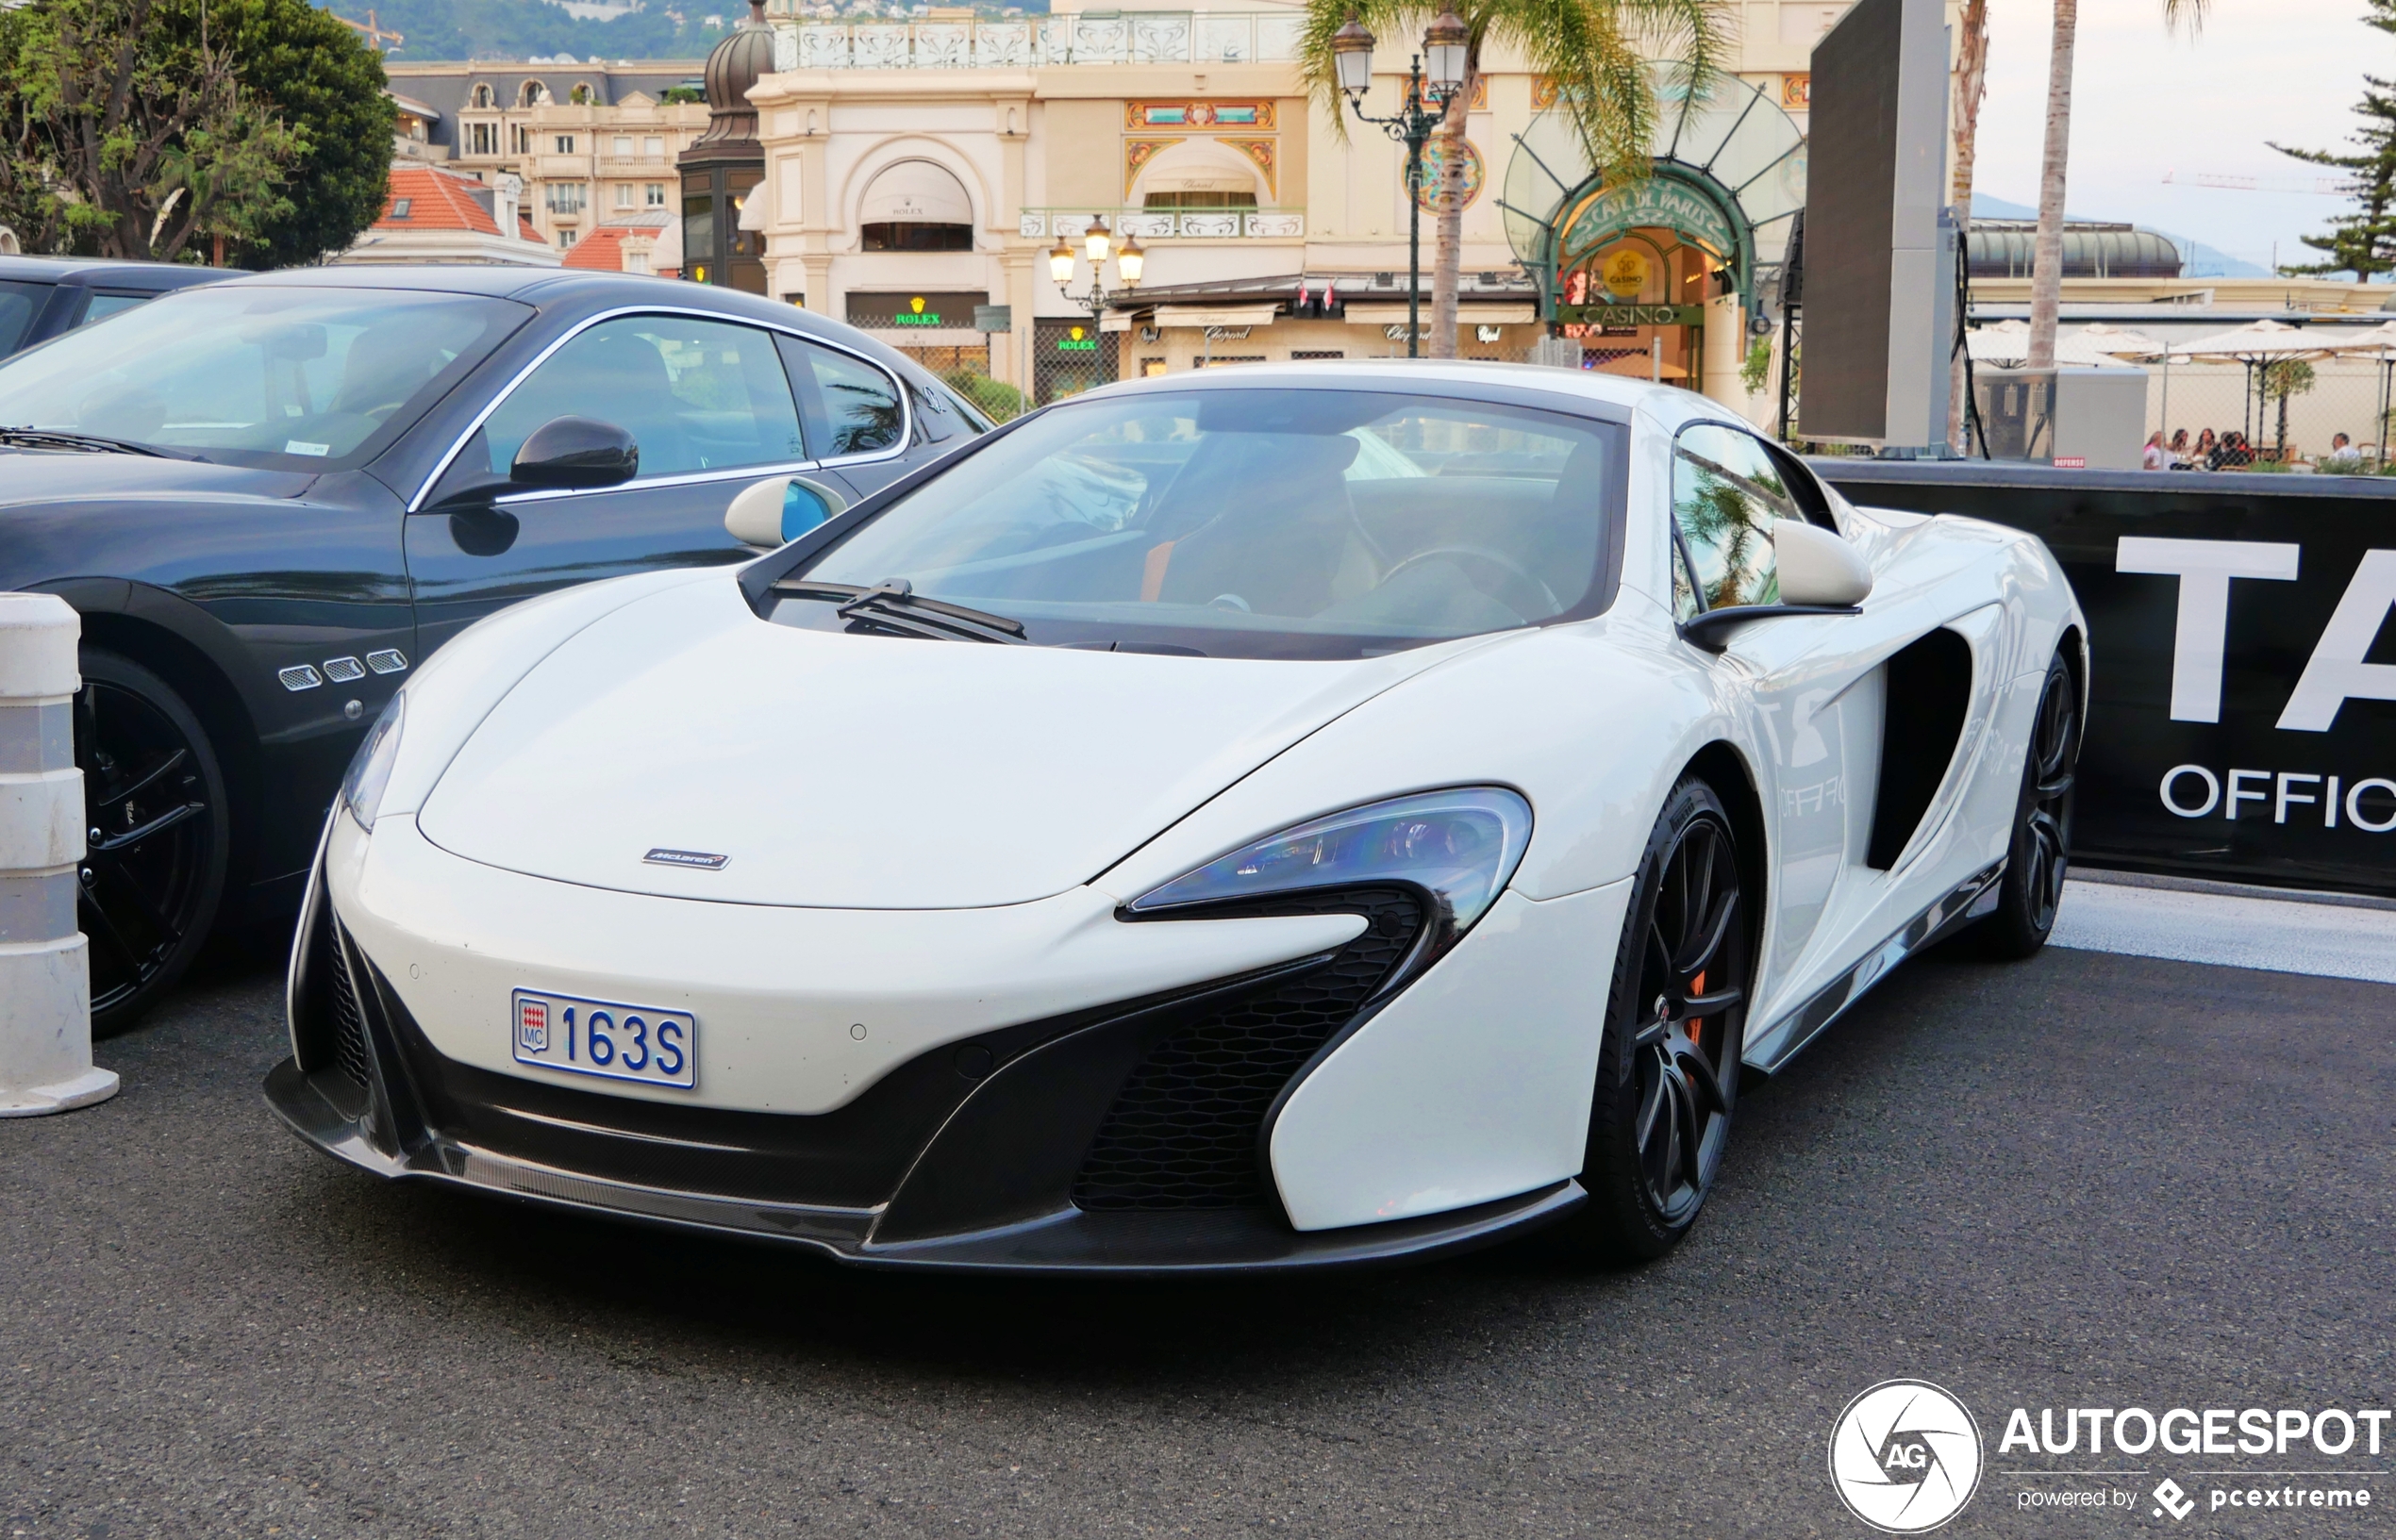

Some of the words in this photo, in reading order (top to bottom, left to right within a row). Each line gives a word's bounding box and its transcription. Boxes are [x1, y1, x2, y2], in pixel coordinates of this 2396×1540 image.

[1660, 191, 1710, 226] PARIS
[896, 314, 940, 325] ROLEX
[1583, 306, 1674, 324] CASINO
[1202, 325, 1253, 342] Chopard
[1057, 340, 1096, 350] ROLEX
[2116, 536, 2396, 732] TA
[2159, 764, 2396, 832] OFFIC
[650, 853, 714, 865] McLaren
[524, 1027, 543, 1045] MC
[563, 1005, 684, 1075] 163S
